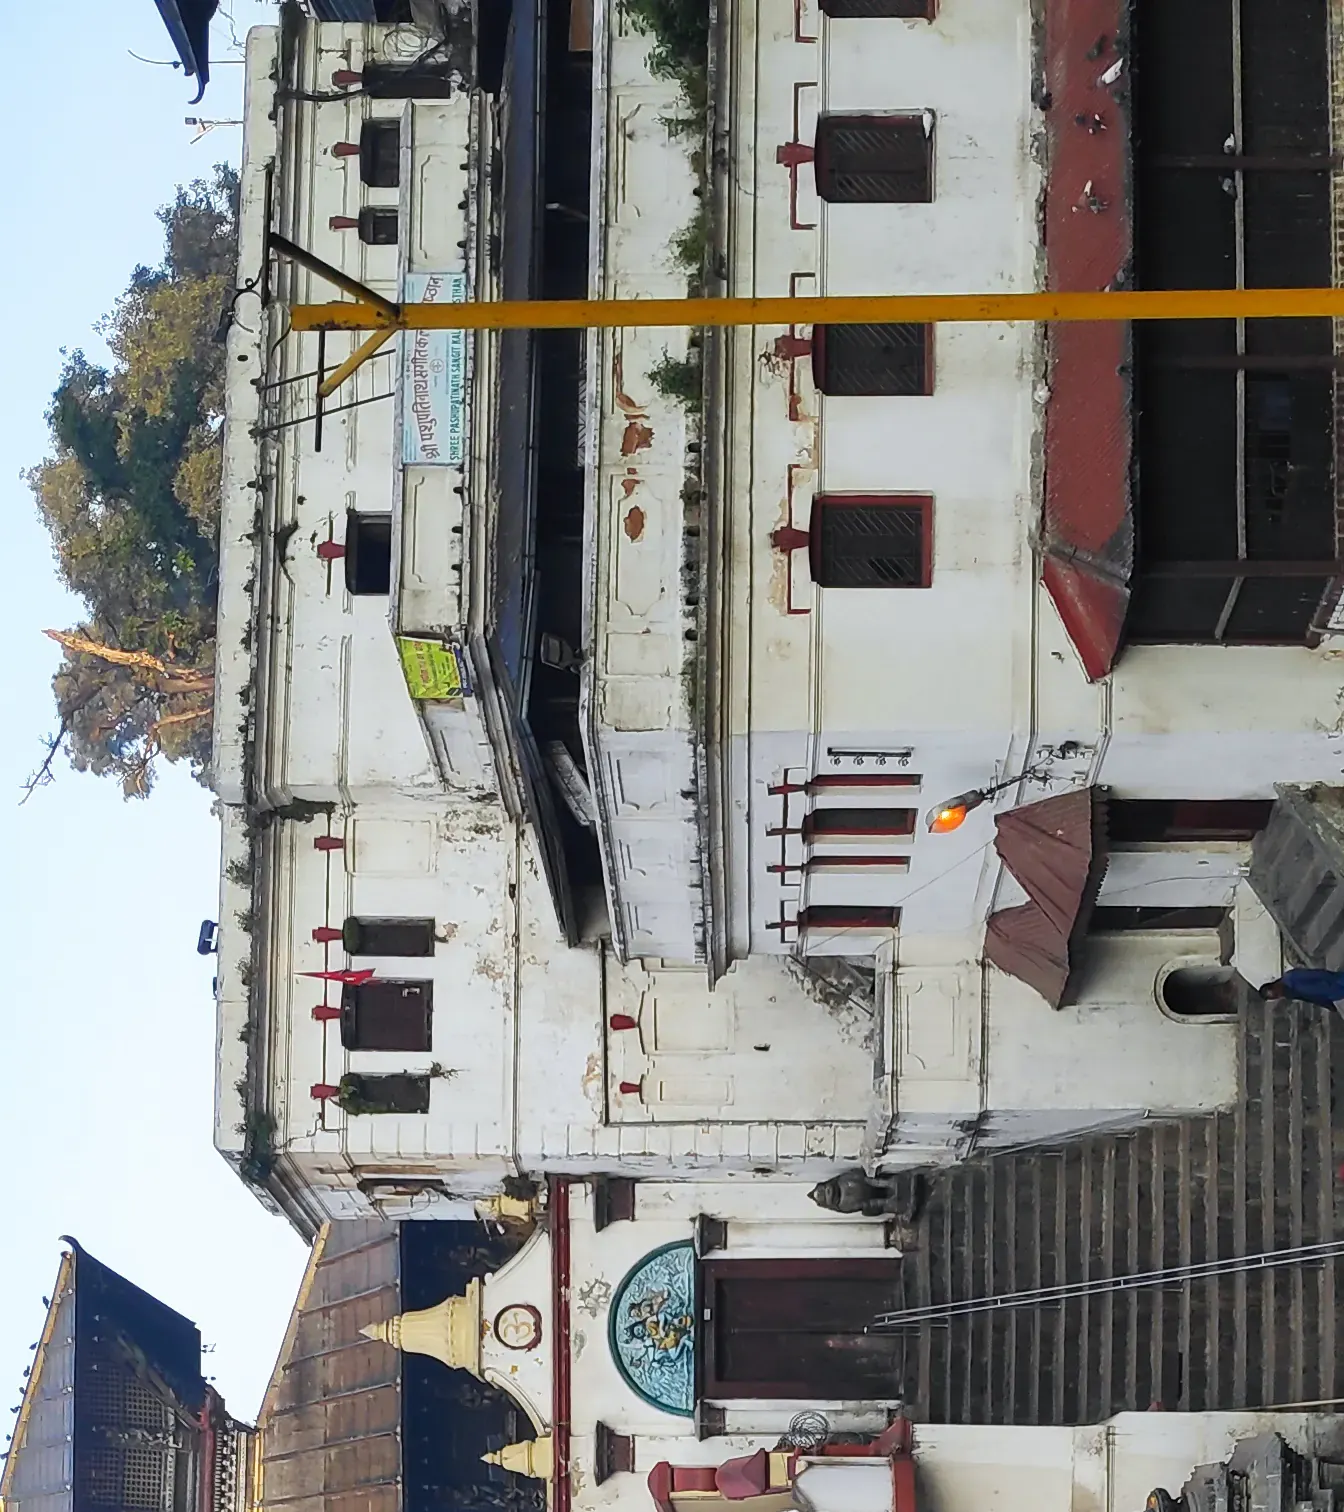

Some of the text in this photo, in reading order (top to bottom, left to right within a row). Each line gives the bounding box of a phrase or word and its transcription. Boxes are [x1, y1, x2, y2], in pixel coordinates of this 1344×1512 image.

[451, 330, 462, 345] KAL
[451, 345, 462, 373] SANGIT
[450, 374, 461, 434] PASHUPATINATH
[419, 444, 440, 459] श्री
[449, 435, 461, 461] SHREE
